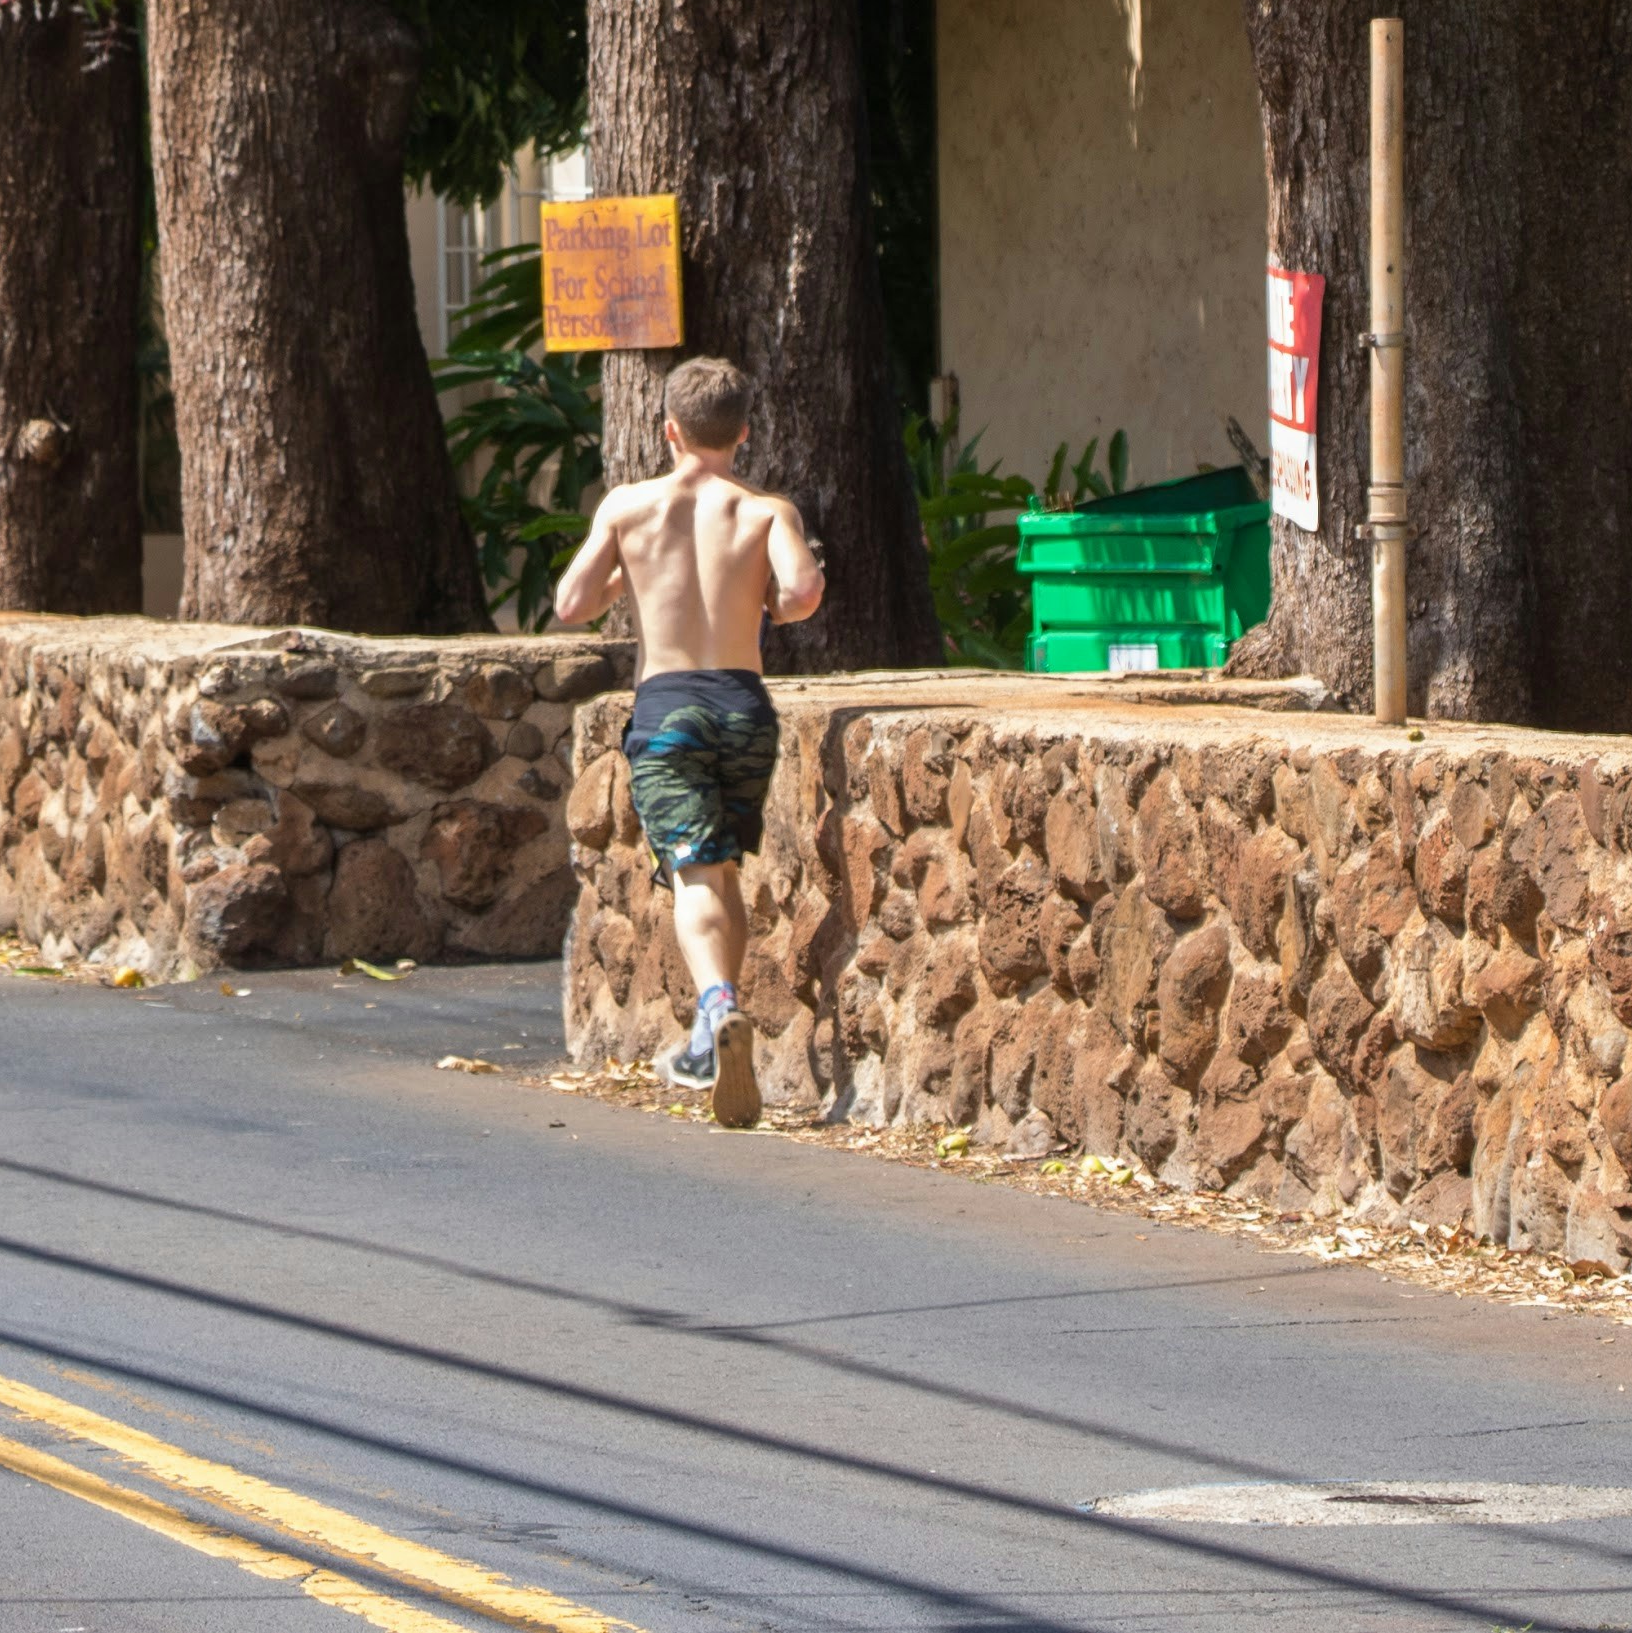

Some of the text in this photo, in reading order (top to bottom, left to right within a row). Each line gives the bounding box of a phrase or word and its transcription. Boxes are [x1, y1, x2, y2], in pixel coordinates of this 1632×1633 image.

[545, 214, 672, 260] Parking Lot
[551, 263, 666, 301] For School
